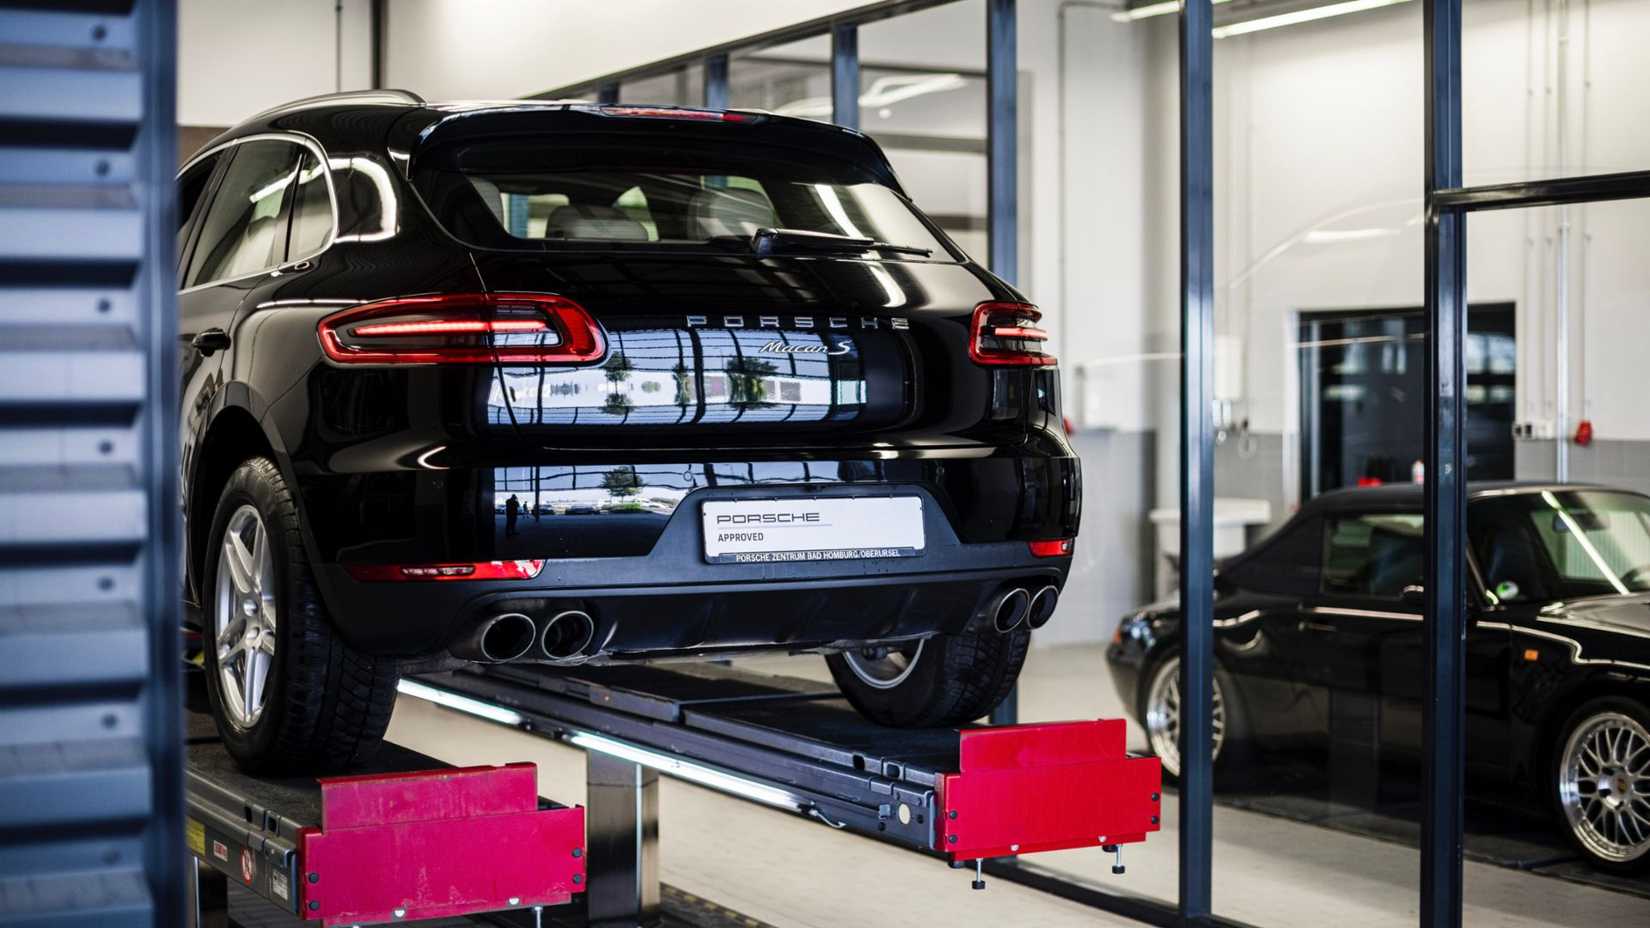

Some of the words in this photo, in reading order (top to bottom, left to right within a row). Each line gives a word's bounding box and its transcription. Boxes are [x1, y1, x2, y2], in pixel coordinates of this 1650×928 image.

[687, 315, 910, 330] PORSCHE
[759, 340, 829, 353] Macan
[827, 339, 851, 356] S
[717, 512, 820, 524] PORSCHE
[718, 532, 764, 542] APPROVED
[736, 552, 770, 563] PORSCHE
[772, 551, 806, 561] ZENTRUM
[807, 550, 822, 560] BAD
[823, 548, 901, 560] HOMBURG/OBERURSEL
